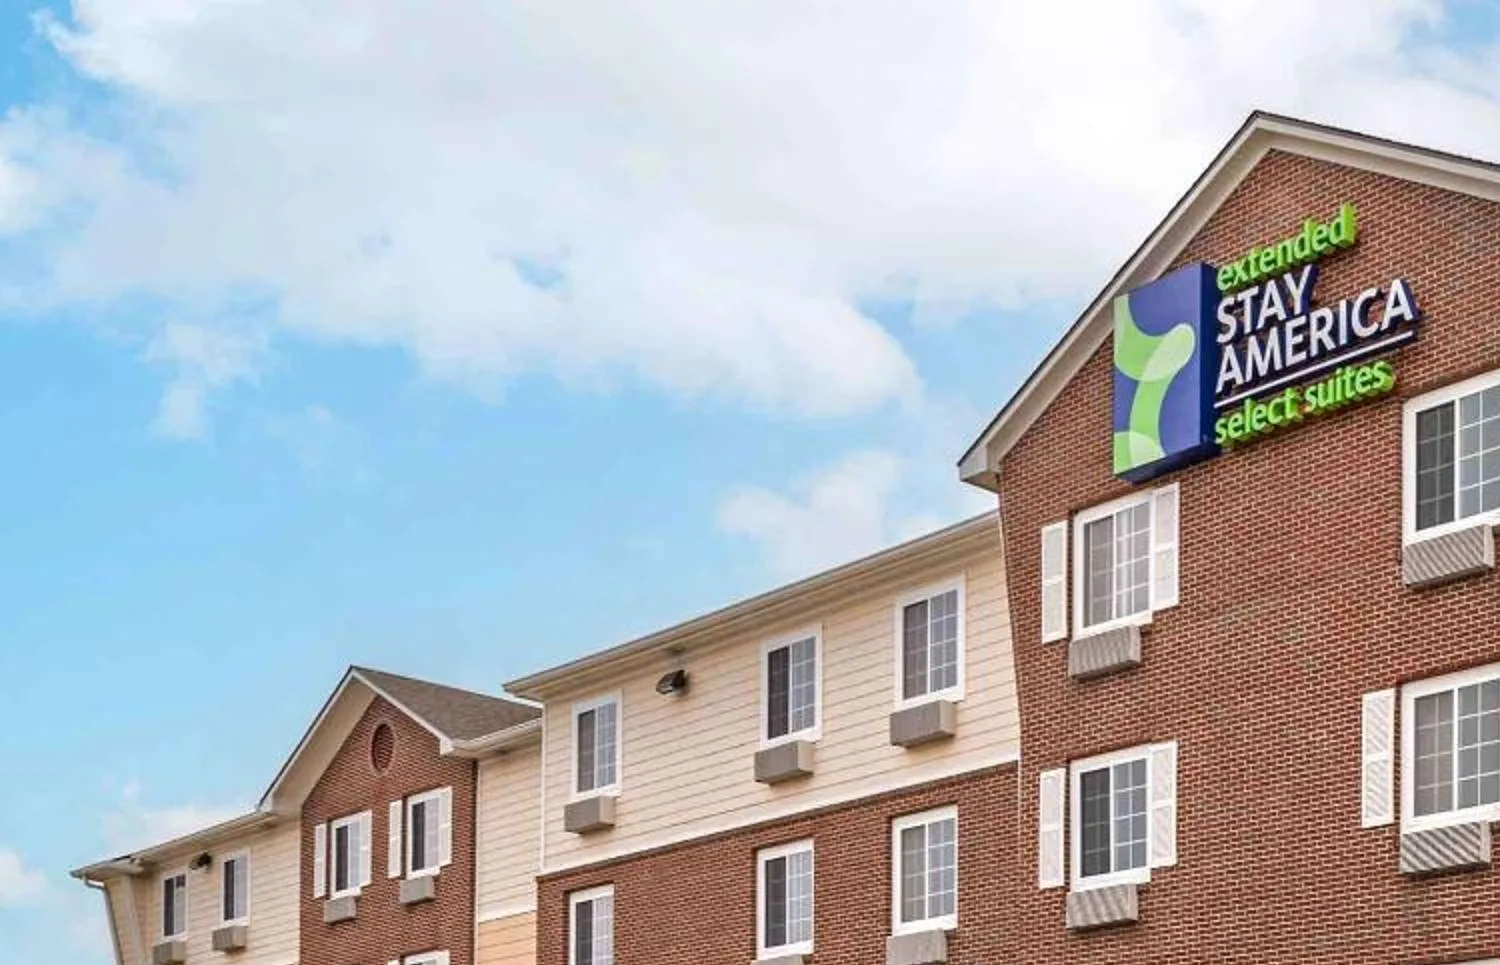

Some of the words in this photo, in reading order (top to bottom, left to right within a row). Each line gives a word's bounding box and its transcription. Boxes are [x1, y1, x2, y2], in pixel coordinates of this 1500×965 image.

[1216, 201, 1357, 290] extended
[1215, 278, 1416, 393] AMERICA
[1216, 263, 1314, 344] STAY
[1214, 388, 1299, 445] select
[1303, 360, 1393, 414] suites
